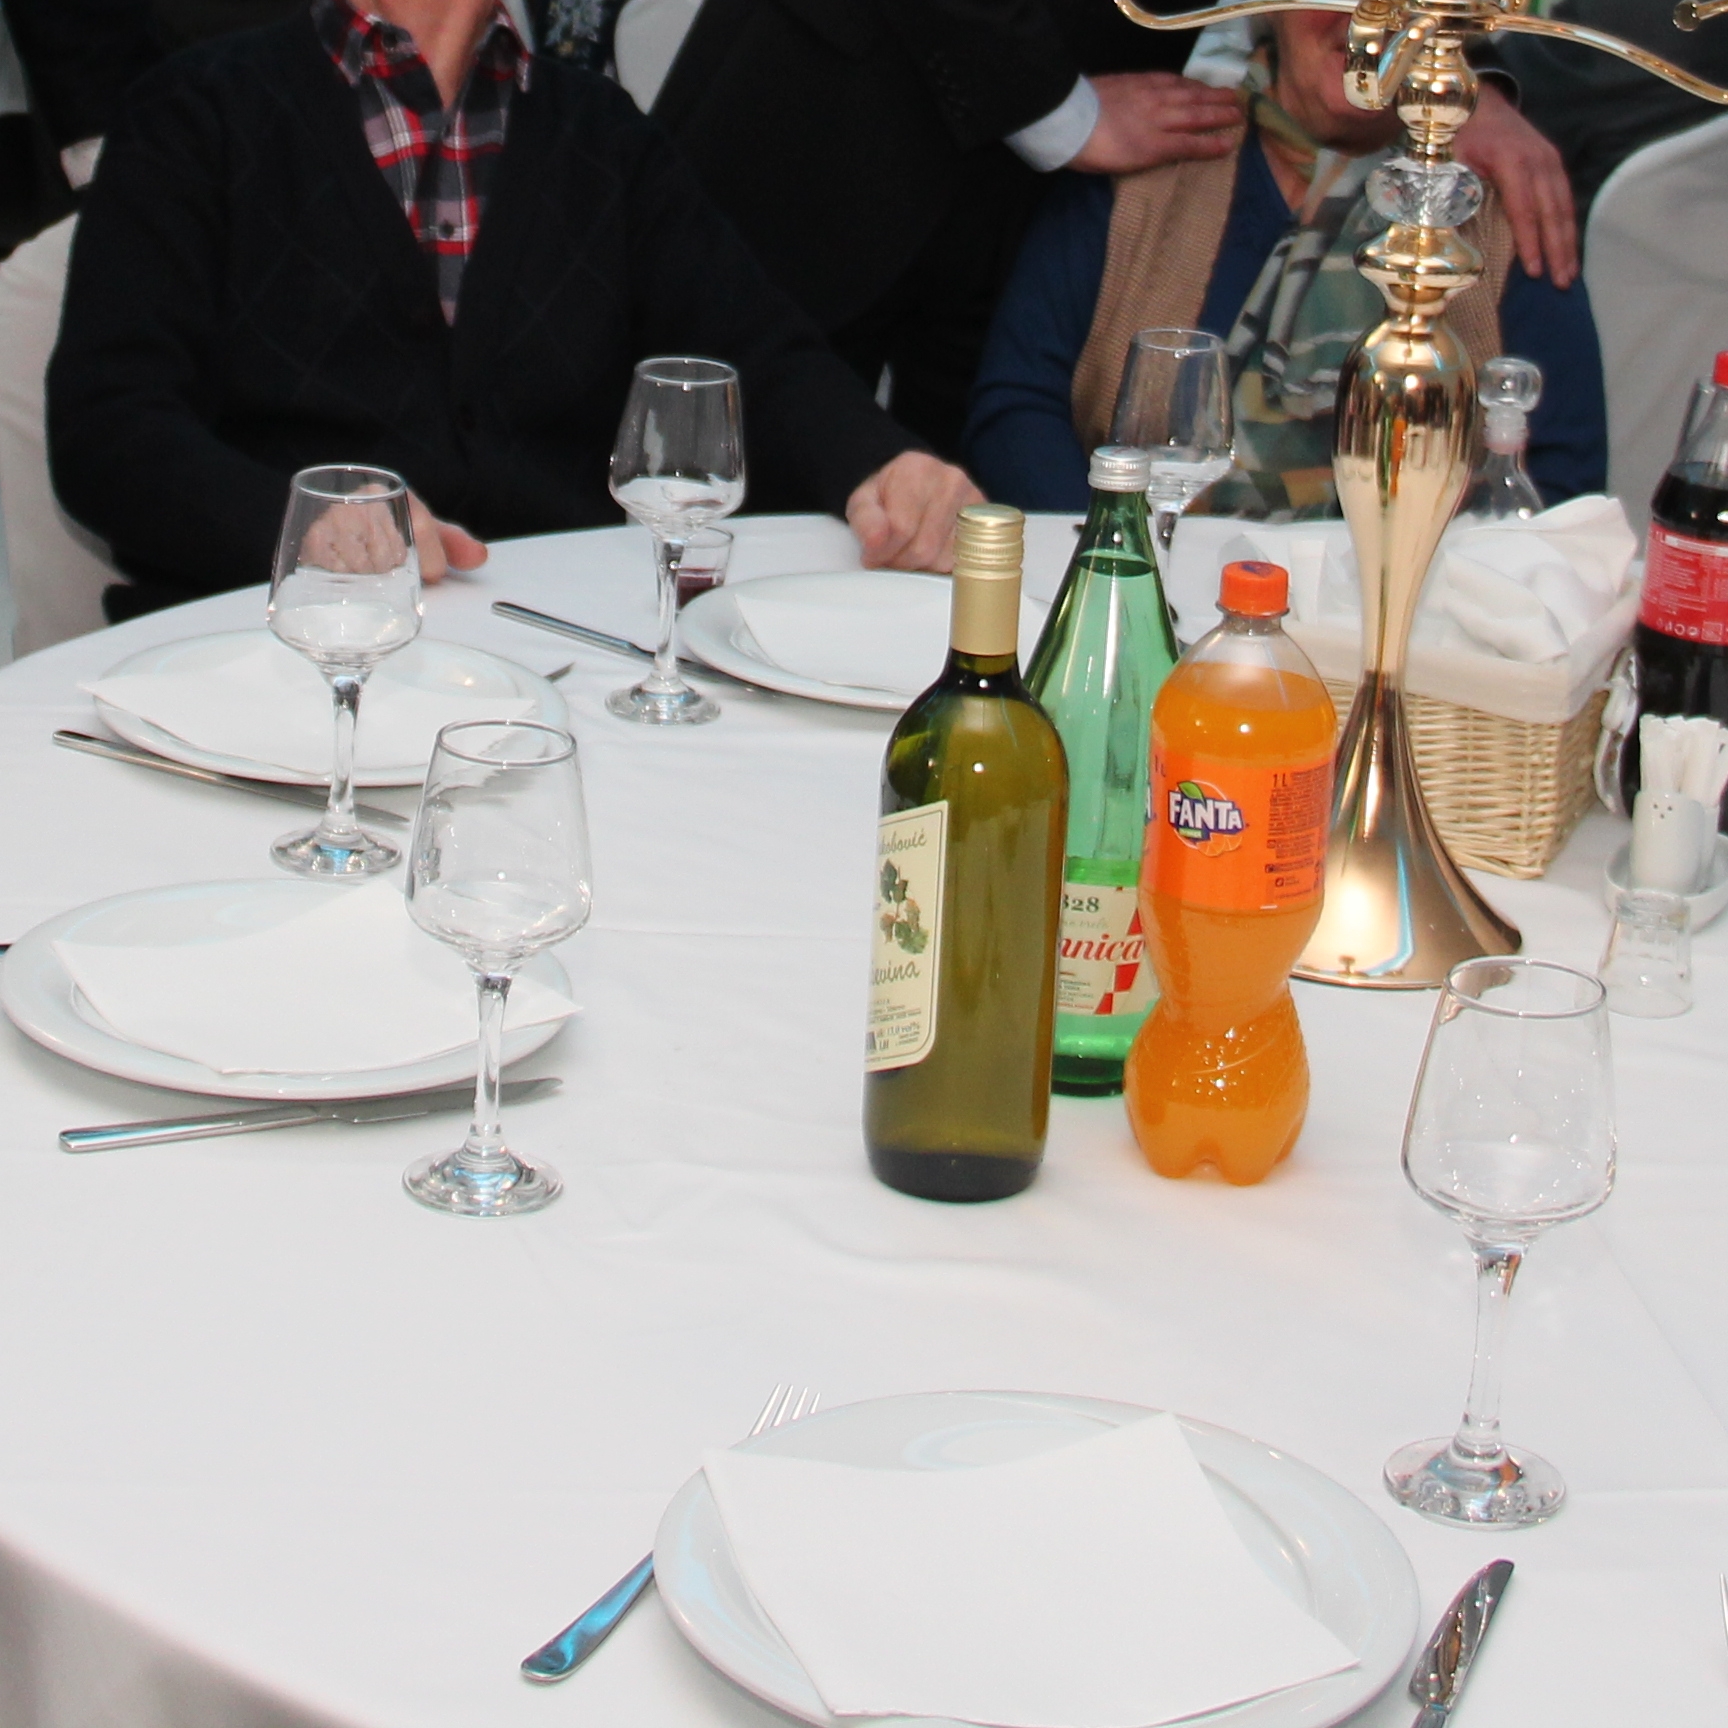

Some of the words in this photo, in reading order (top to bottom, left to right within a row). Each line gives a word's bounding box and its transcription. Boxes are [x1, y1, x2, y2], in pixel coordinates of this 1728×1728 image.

[1168, 790, 1244, 832] FANTA
[879, 827, 928, 855] kobović
[1060, 933, 1145, 962] nica
